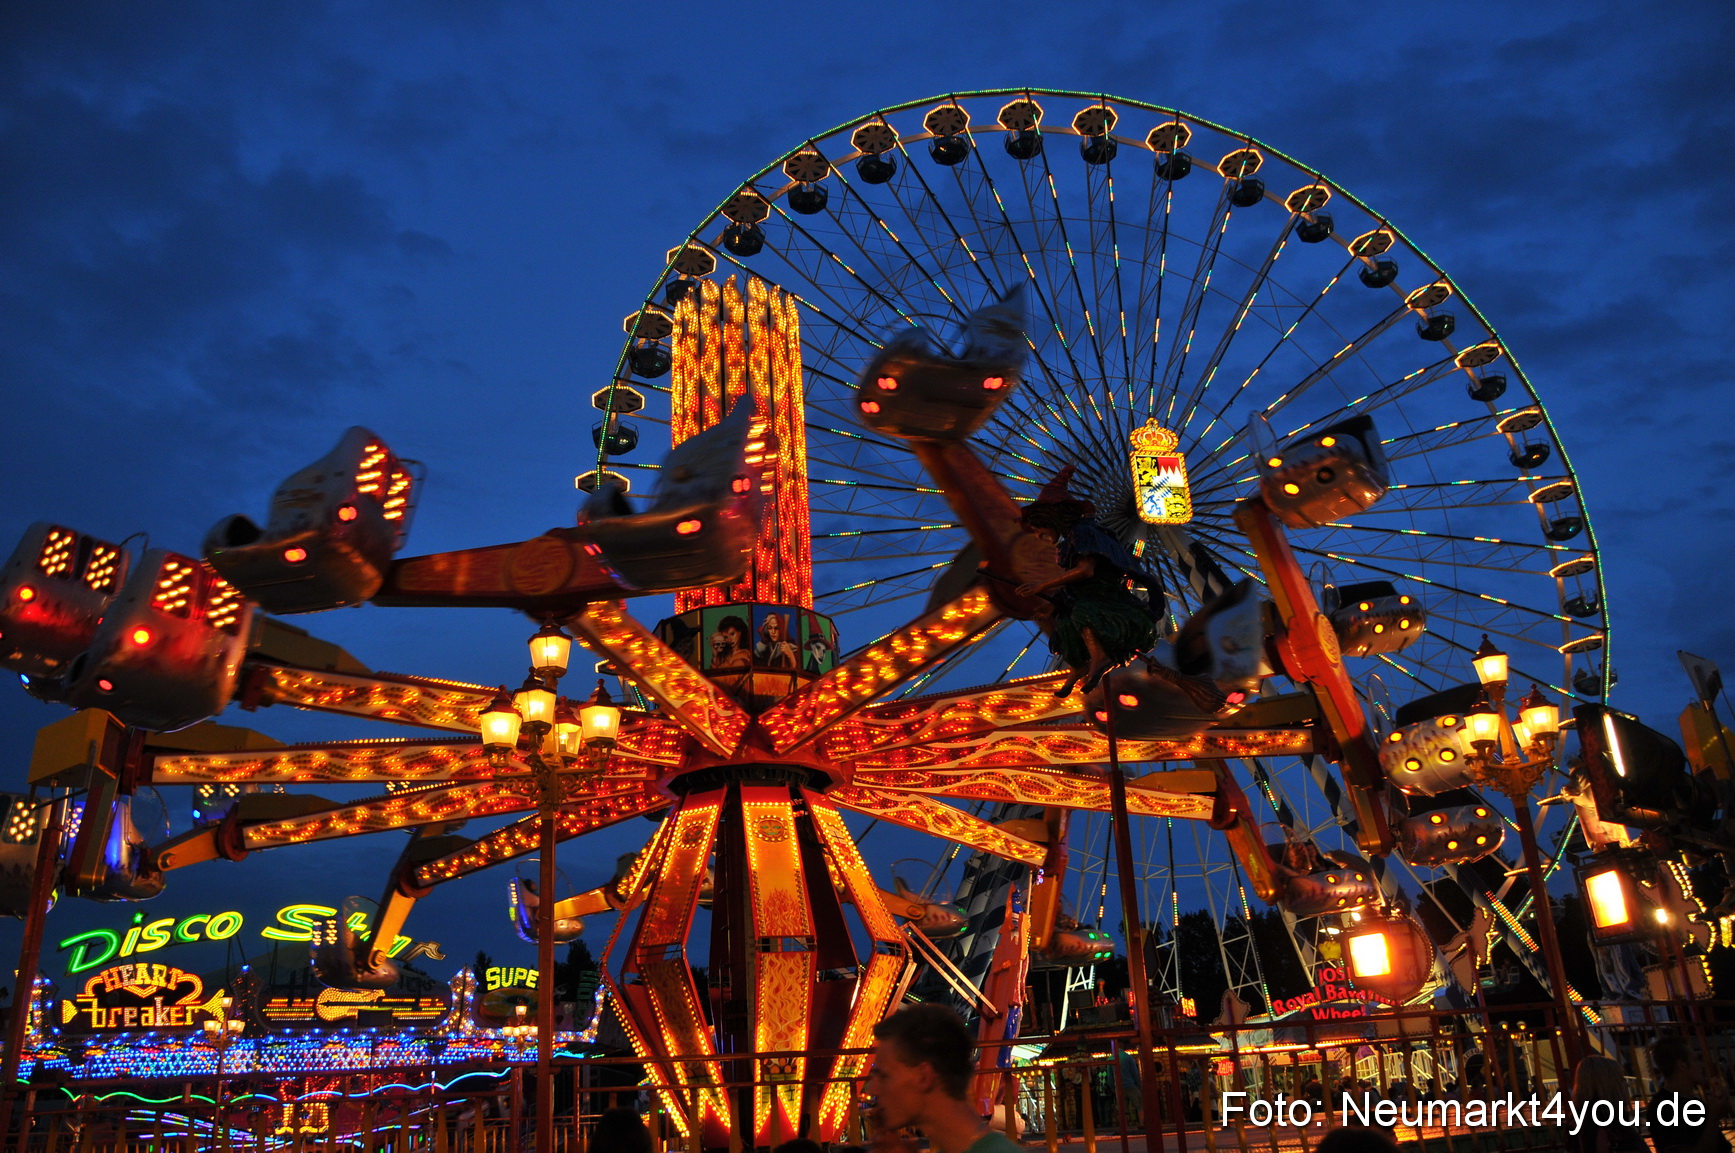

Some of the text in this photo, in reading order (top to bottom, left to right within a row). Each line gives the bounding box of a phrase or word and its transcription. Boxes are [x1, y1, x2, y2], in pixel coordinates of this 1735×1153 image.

[58, 908, 244, 975] Disco
[102, 962, 185, 993] HEART
[485, 966, 540, 991] SUPE
[79, 995, 199, 1028] breaker
[1272, 986, 1320, 1016] Royal
[1312, 1005, 1366, 1020] Wheel
